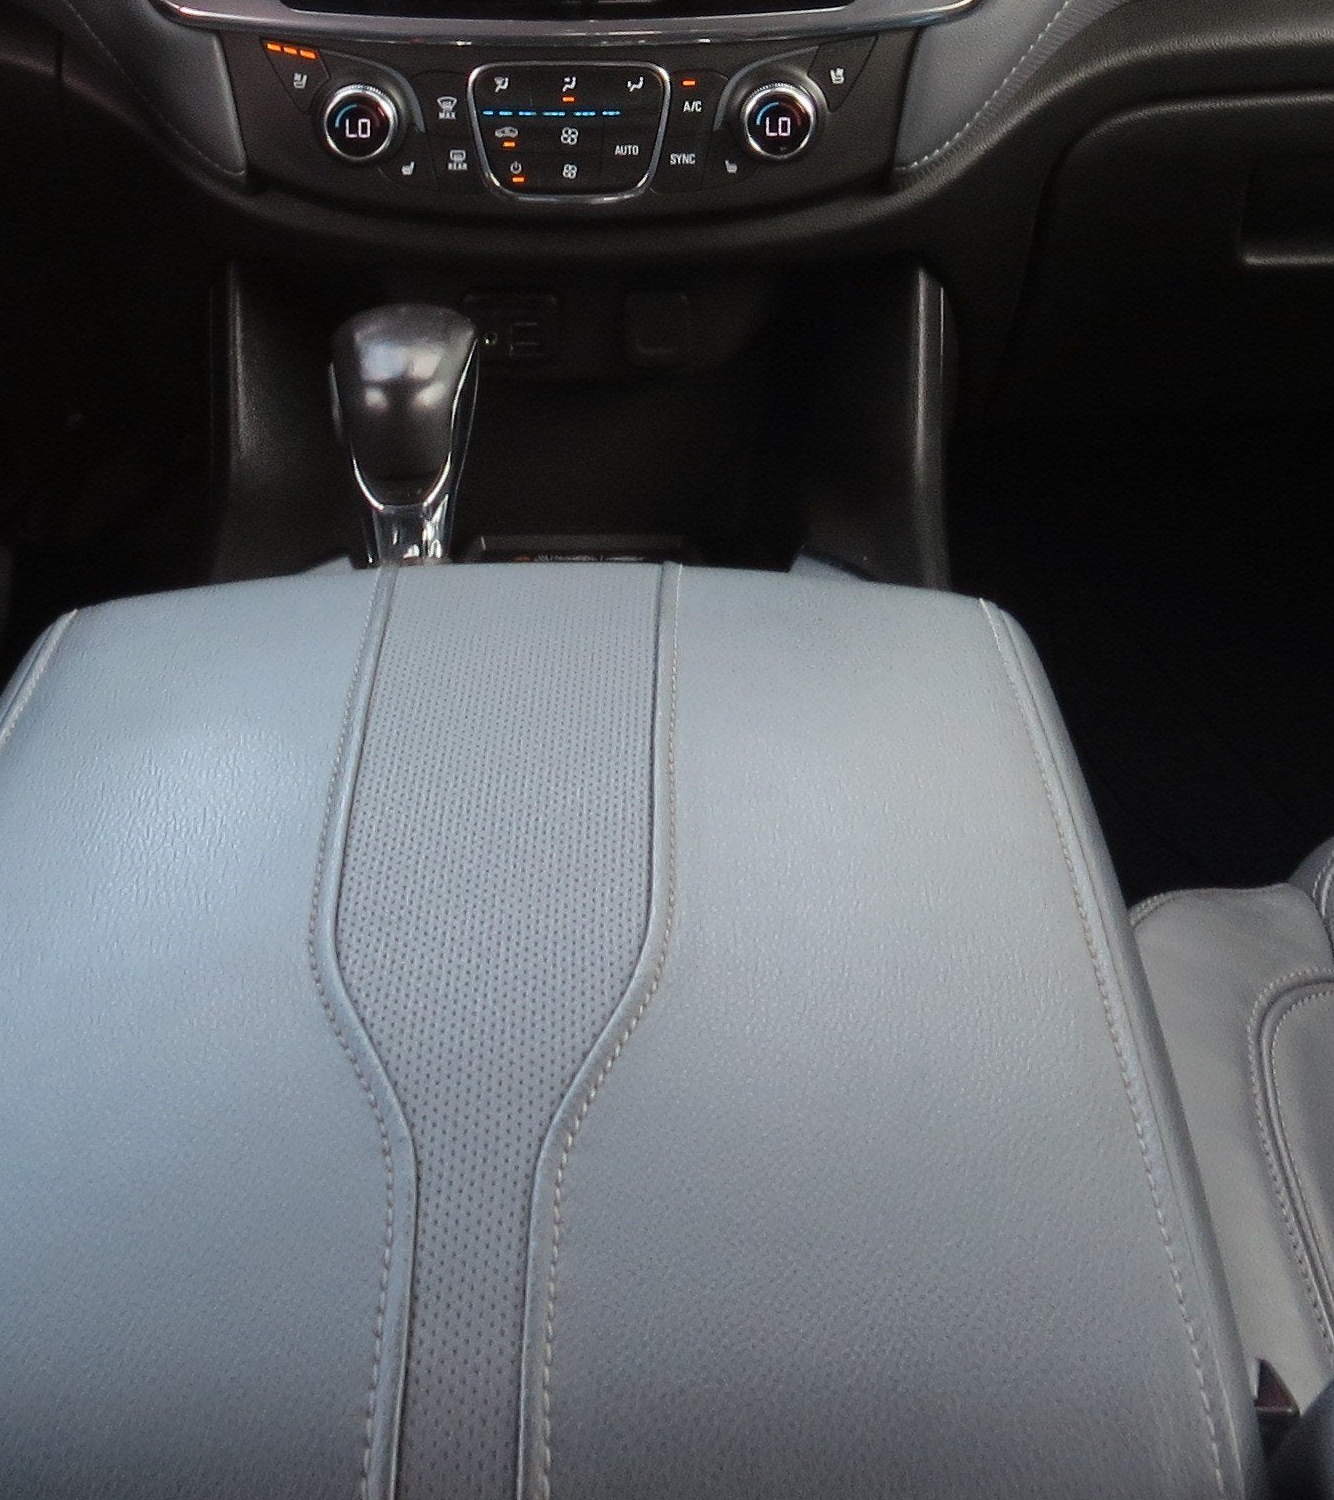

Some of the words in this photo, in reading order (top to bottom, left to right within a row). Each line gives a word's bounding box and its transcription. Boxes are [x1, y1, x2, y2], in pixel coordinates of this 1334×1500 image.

[682, 100, 702, 113] A/C
[438, 111, 457, 120] MAX
[344, 117, 372, 139] LO
[764, 116, 791, 137] LO
[614, 144, 640, 156] AUTO
[669, 153, 696, 165] SYNC
[447, 162, 468, 171] REAR
